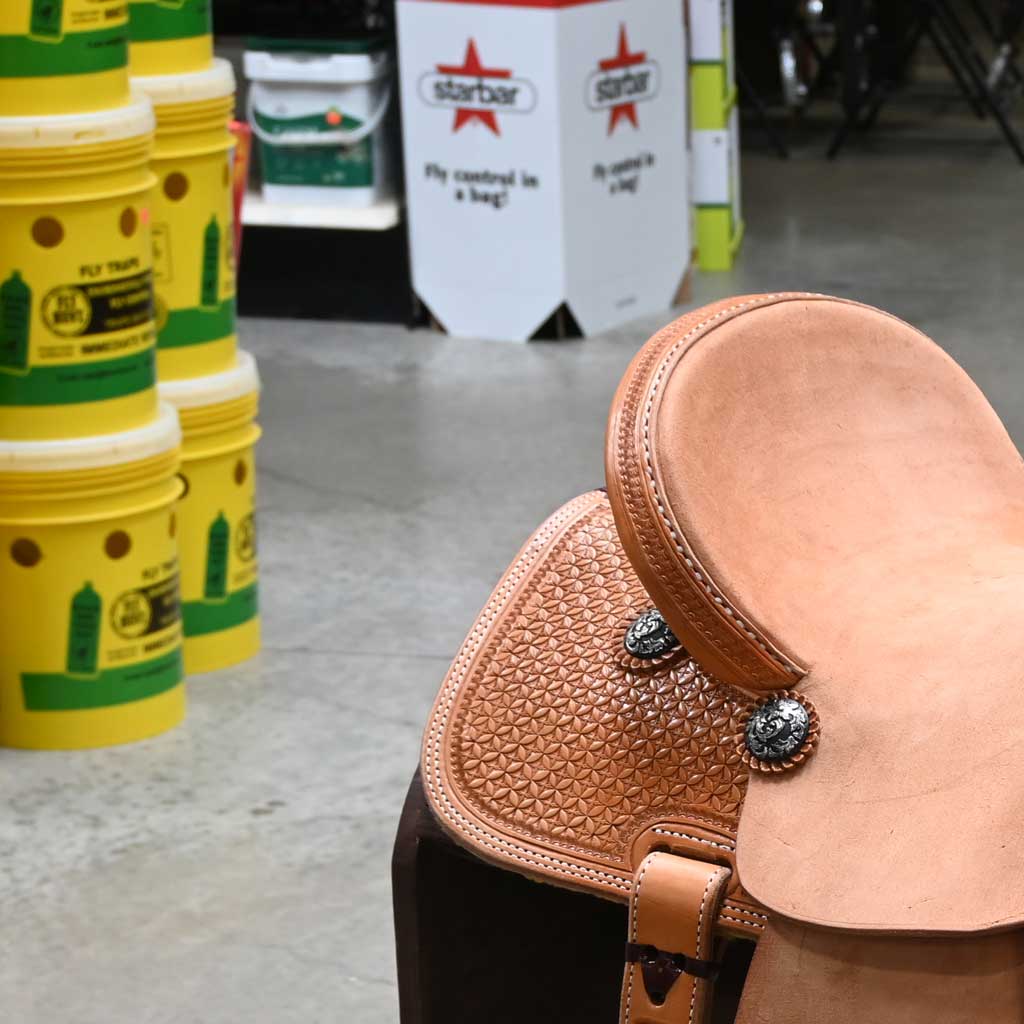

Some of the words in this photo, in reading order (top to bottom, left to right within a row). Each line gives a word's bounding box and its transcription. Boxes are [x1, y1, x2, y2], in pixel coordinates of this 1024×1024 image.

[434, 79, 518, 105] starbar
[425, 162, 447, 184] Fly
[454, 170, 514, 186] control
